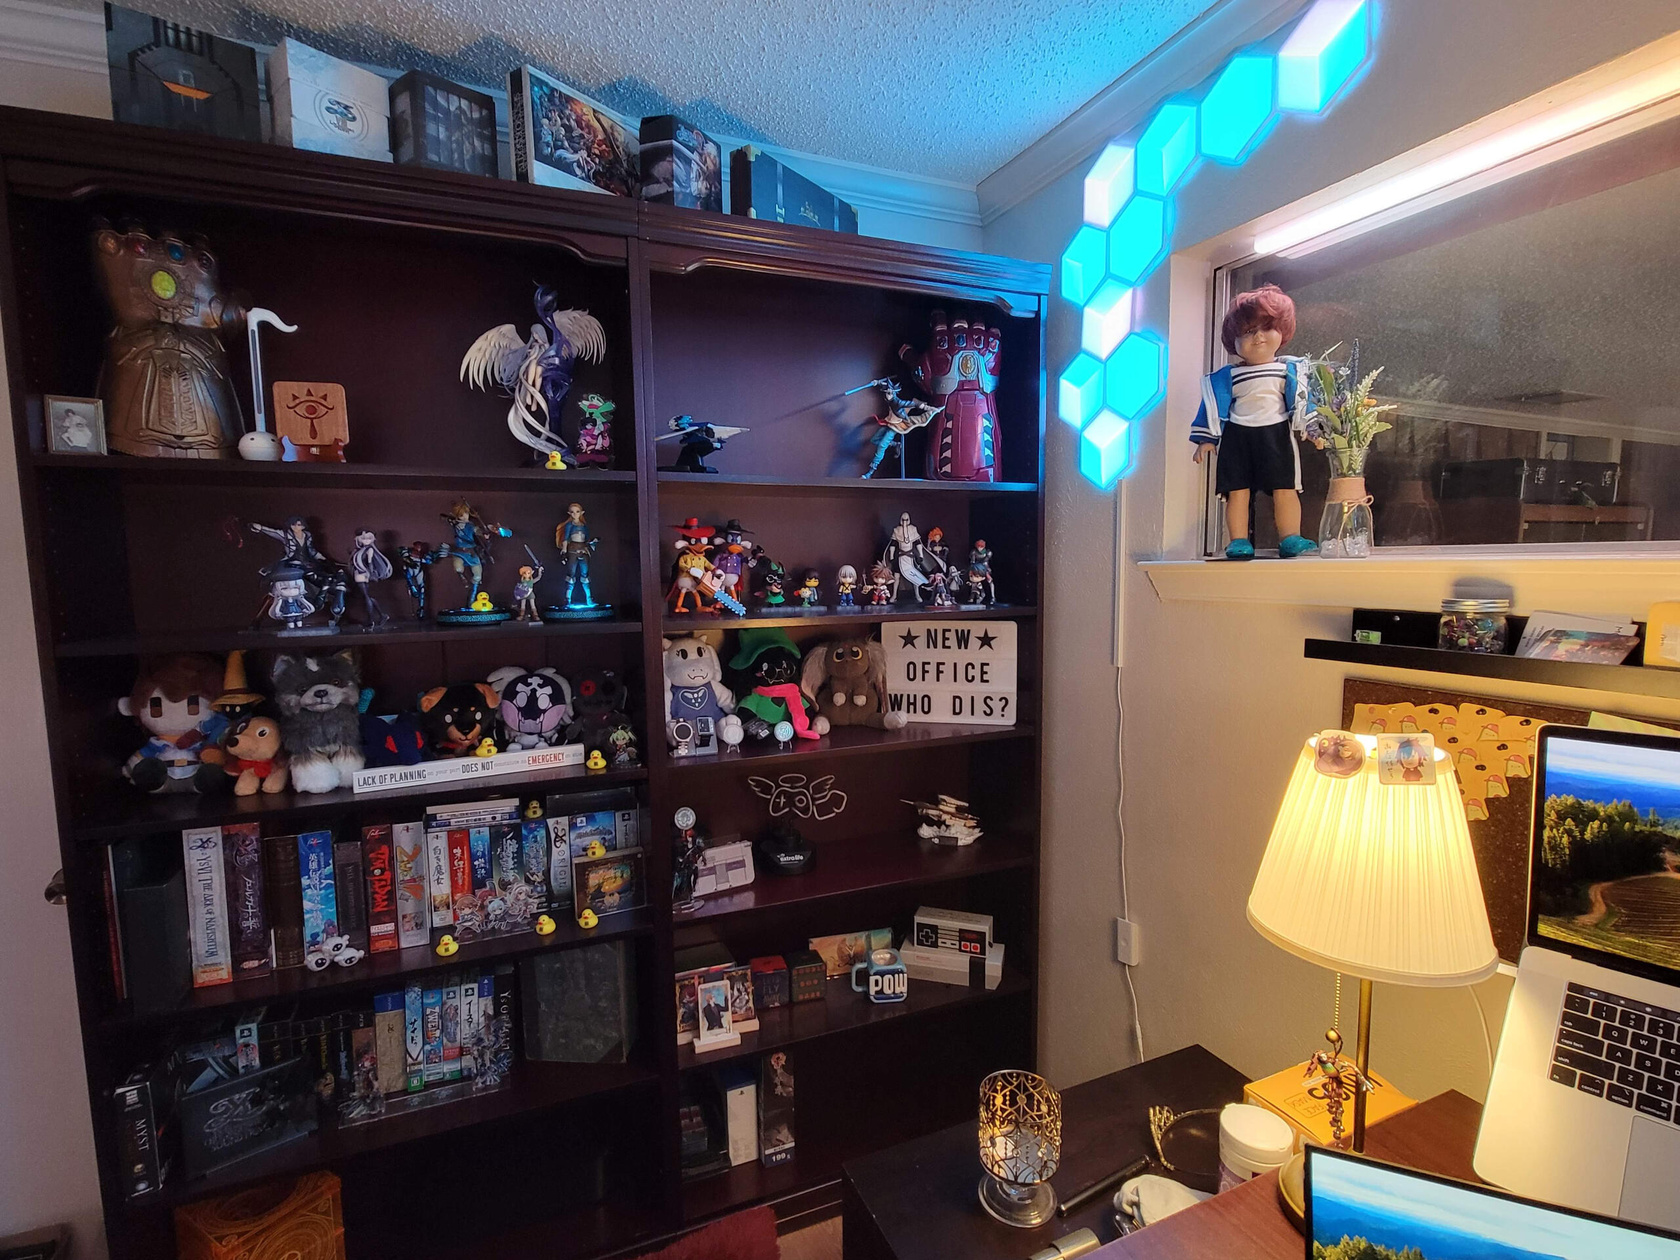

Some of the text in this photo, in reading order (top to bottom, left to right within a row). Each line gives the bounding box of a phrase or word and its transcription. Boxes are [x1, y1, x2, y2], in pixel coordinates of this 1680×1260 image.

[926, 628, 971, 650] NEW
[906, 661, 990, 683] OFFICE
[888, 693, 1009, 718] WHO DIS?
[357, 774, 377, 787] LACK
[379, 773, 388, 784] OF
[389, 770, 427, 783] PLANNING
[461, 762, 479, 774] DOES
[481, 761, 494, 771] NOT
[527, 752, 565, 765] EMERGENCY
[869, 973, 908, 996] POW
[135, 1119, 150, 1151] MYST
